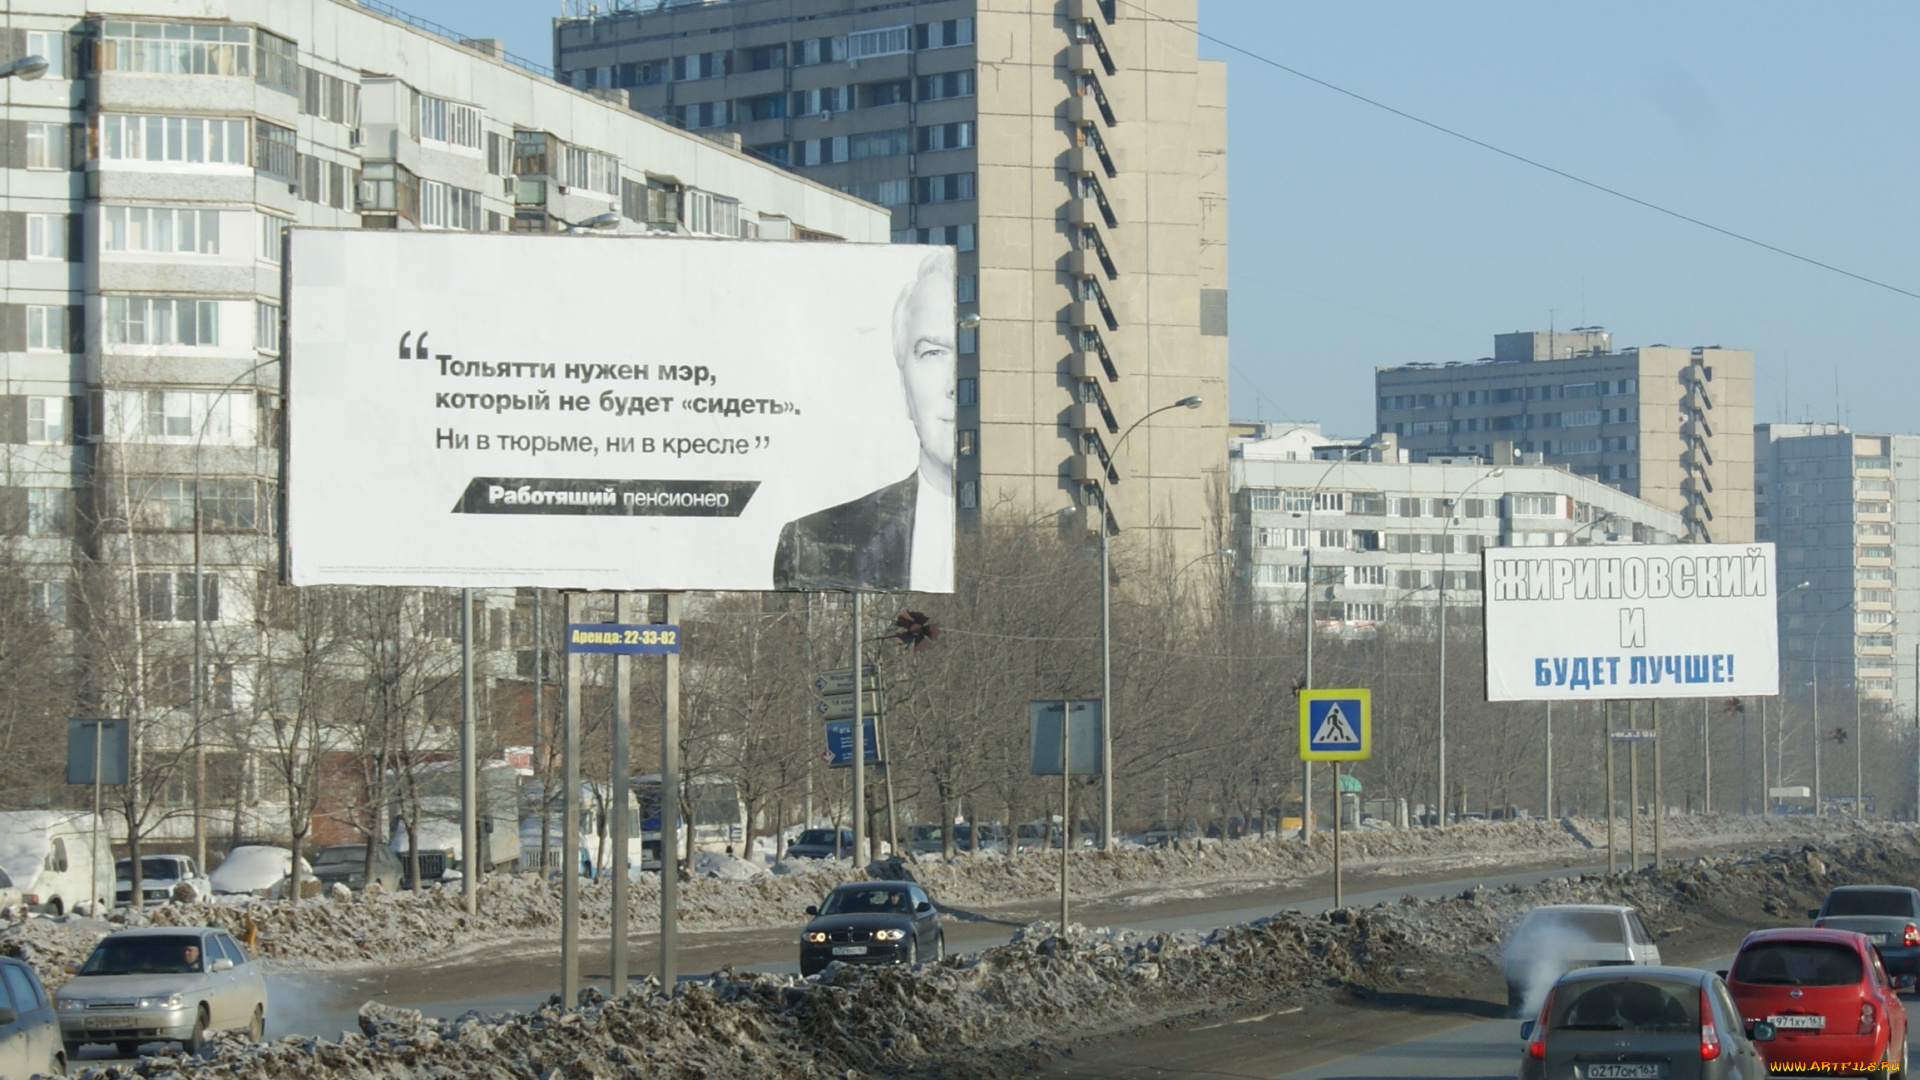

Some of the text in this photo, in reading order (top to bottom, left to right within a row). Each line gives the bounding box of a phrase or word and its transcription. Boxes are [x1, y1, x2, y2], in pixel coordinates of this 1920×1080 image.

[564, 362, 649, 384] нужен
[658, 363, 717, 386] мэр,
[435, 389, 801, 417] который не будет «сидеть».
[435, 427, 469, 450] Ни
[476, 434, 490, 450] в
[496, 434, 599, 456] тюрьме,
[606, 437, 635, 453] ни
[642, 437, 656, 453] в
[488, 485, 730, 509] Работящий пенсионер
[1493, 547, 1767, 601] ЖИРИНОВСКИЙ
[571, 629, 622, 645] Аренда:
[1619, 607, 1646, 648] И
[1534, 654, 1735, 690] БУДЕТ ЛУЧШЕ!
